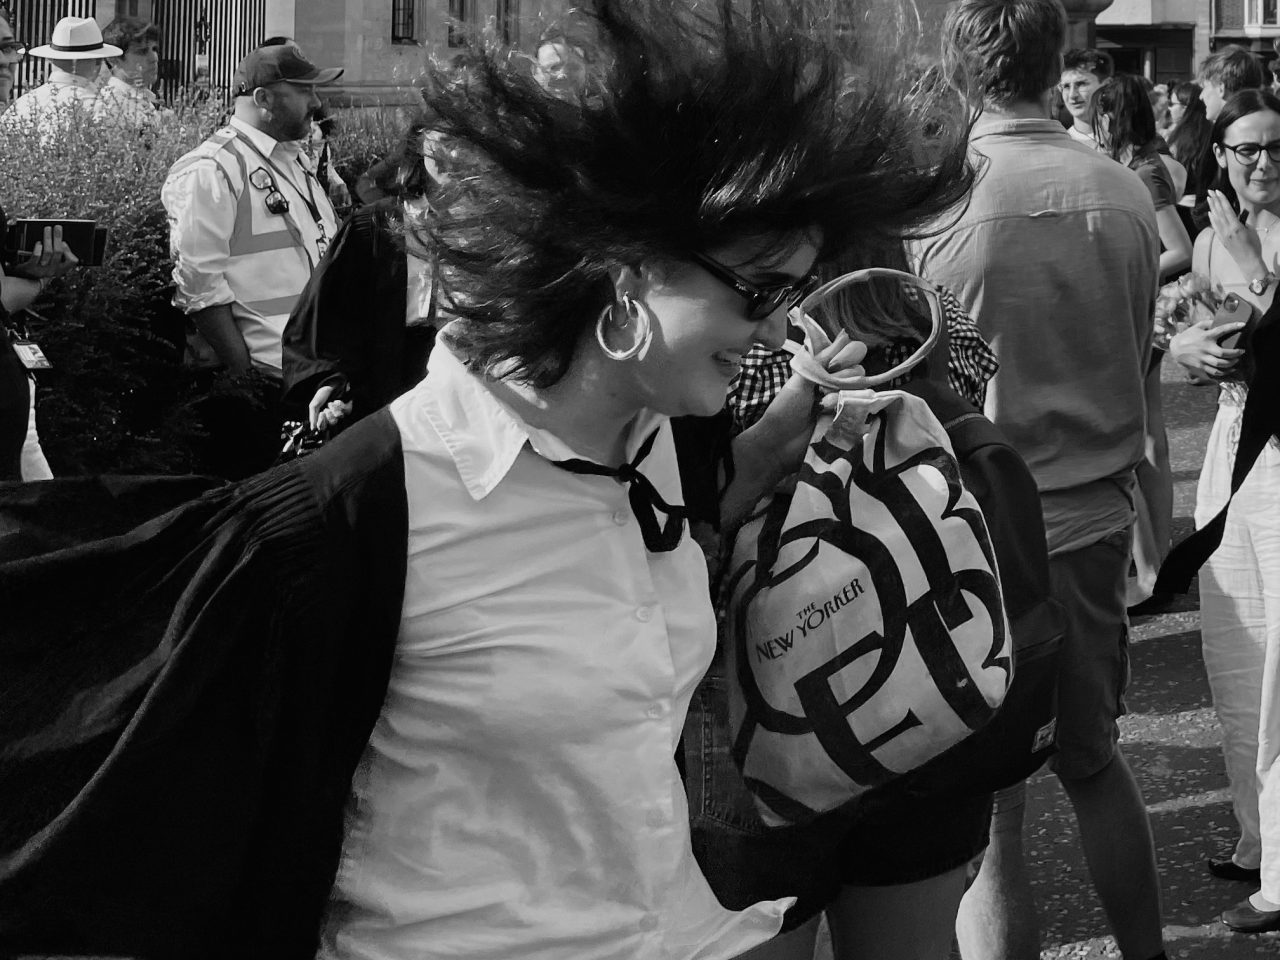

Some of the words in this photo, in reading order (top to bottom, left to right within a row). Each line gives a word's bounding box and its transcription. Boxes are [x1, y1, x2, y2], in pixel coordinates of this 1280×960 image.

[756, 629, 794, 664] NEW
[796, 578, 865, 638] YORKER
[796, 602, 817, 619] THE
